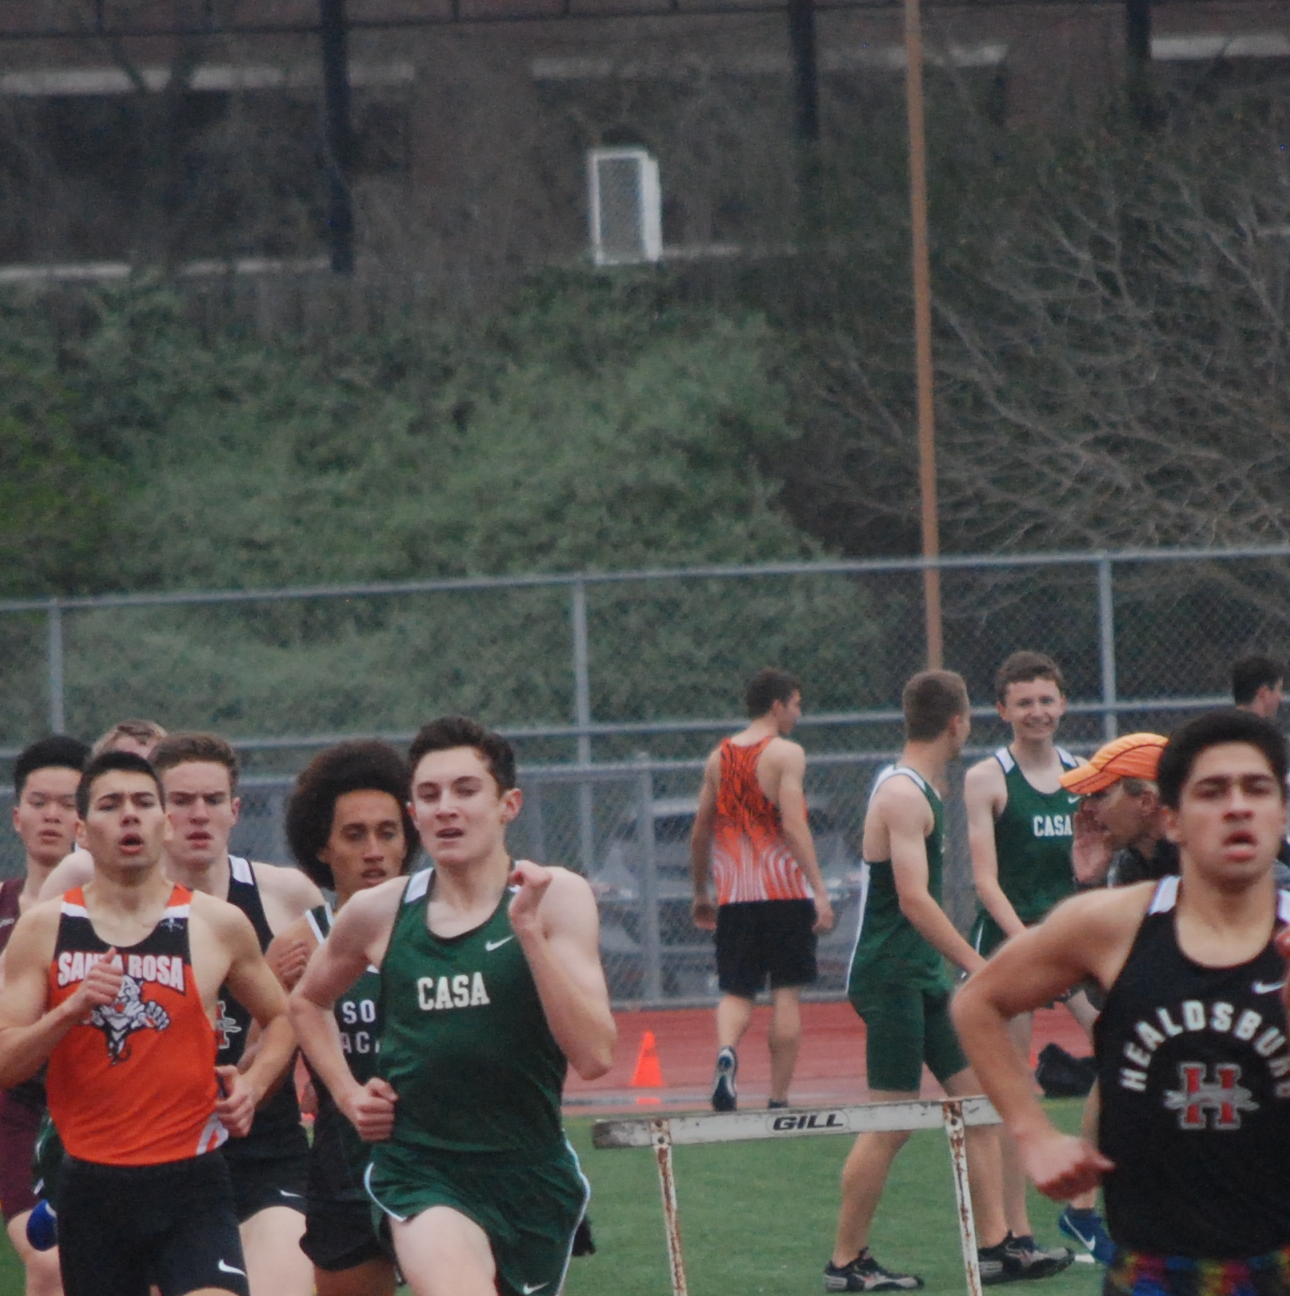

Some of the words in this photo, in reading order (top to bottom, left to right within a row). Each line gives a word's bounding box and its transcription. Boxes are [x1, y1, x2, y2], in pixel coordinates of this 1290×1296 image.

[1033, 814, 1073, 837] CASA
[127, 953, 186, 992] ROSA
[417, 971, 491, 1011] CASA
[772, 1113, 844, 1131] GILL
